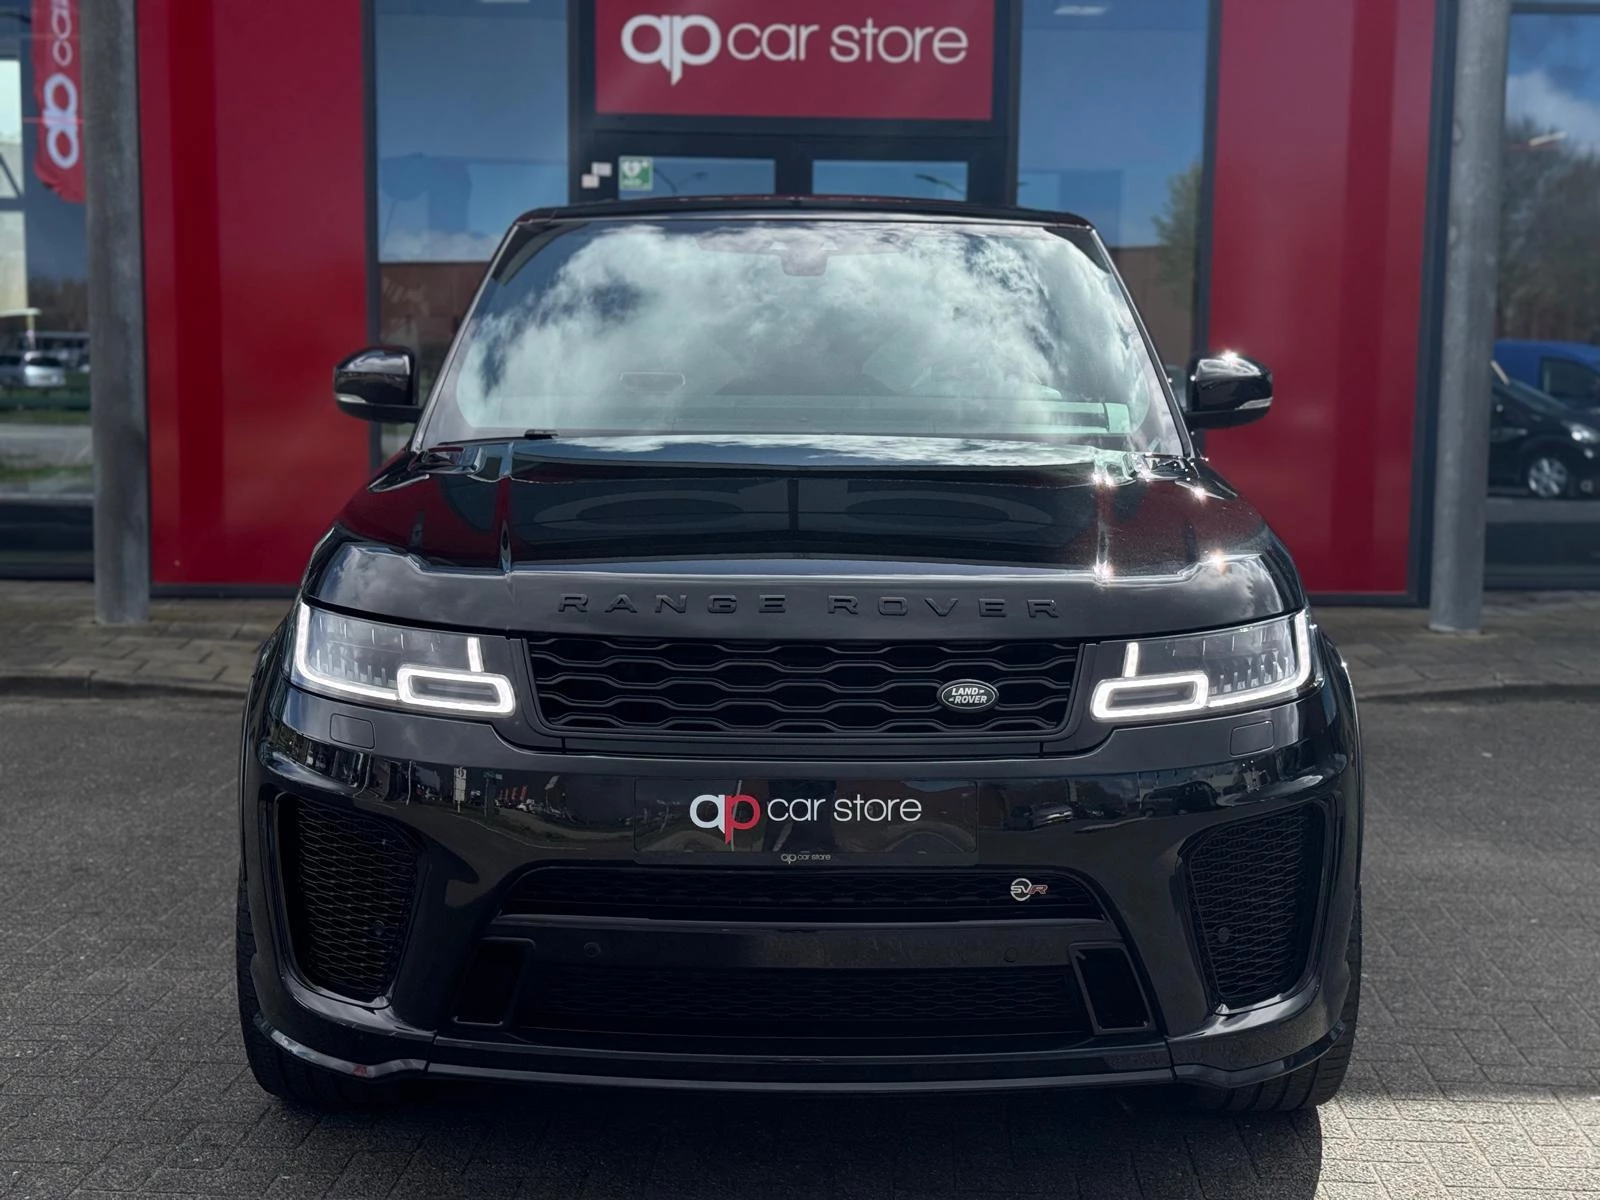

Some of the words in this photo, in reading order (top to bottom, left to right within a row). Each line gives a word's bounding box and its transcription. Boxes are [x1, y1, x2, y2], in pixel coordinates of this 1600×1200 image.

[727, 23, 819, 61] car
[830, 18, 969, 64] store
[558, 593, 786, 613] RANGE
[827, 595, 1059, 618] ROVER
[767, 798, 826, 822] car
[833, 794, 922, 822] store
